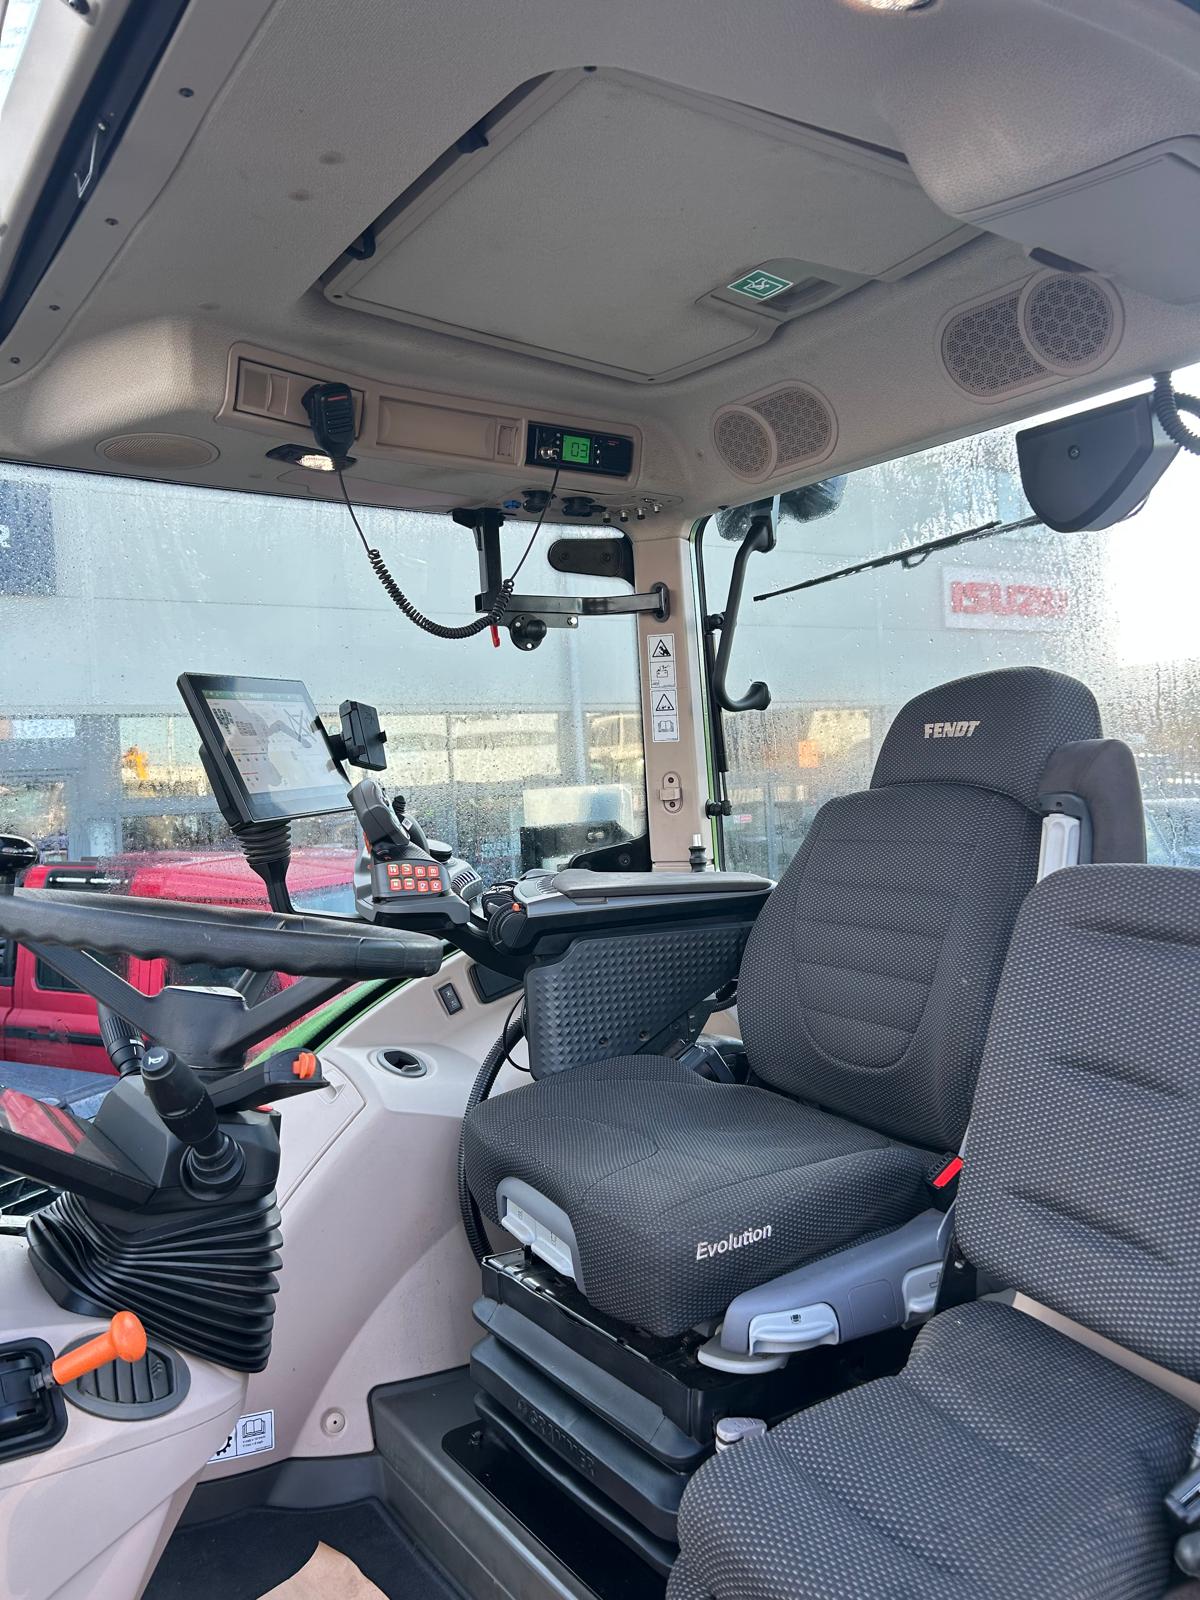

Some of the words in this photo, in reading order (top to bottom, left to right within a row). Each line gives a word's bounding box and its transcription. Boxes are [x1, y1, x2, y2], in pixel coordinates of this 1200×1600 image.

[570, 442, 588, 459] 03
[924, 720, 980, 738] FENDT
[696, 1225, 772, 1260] Evolution
